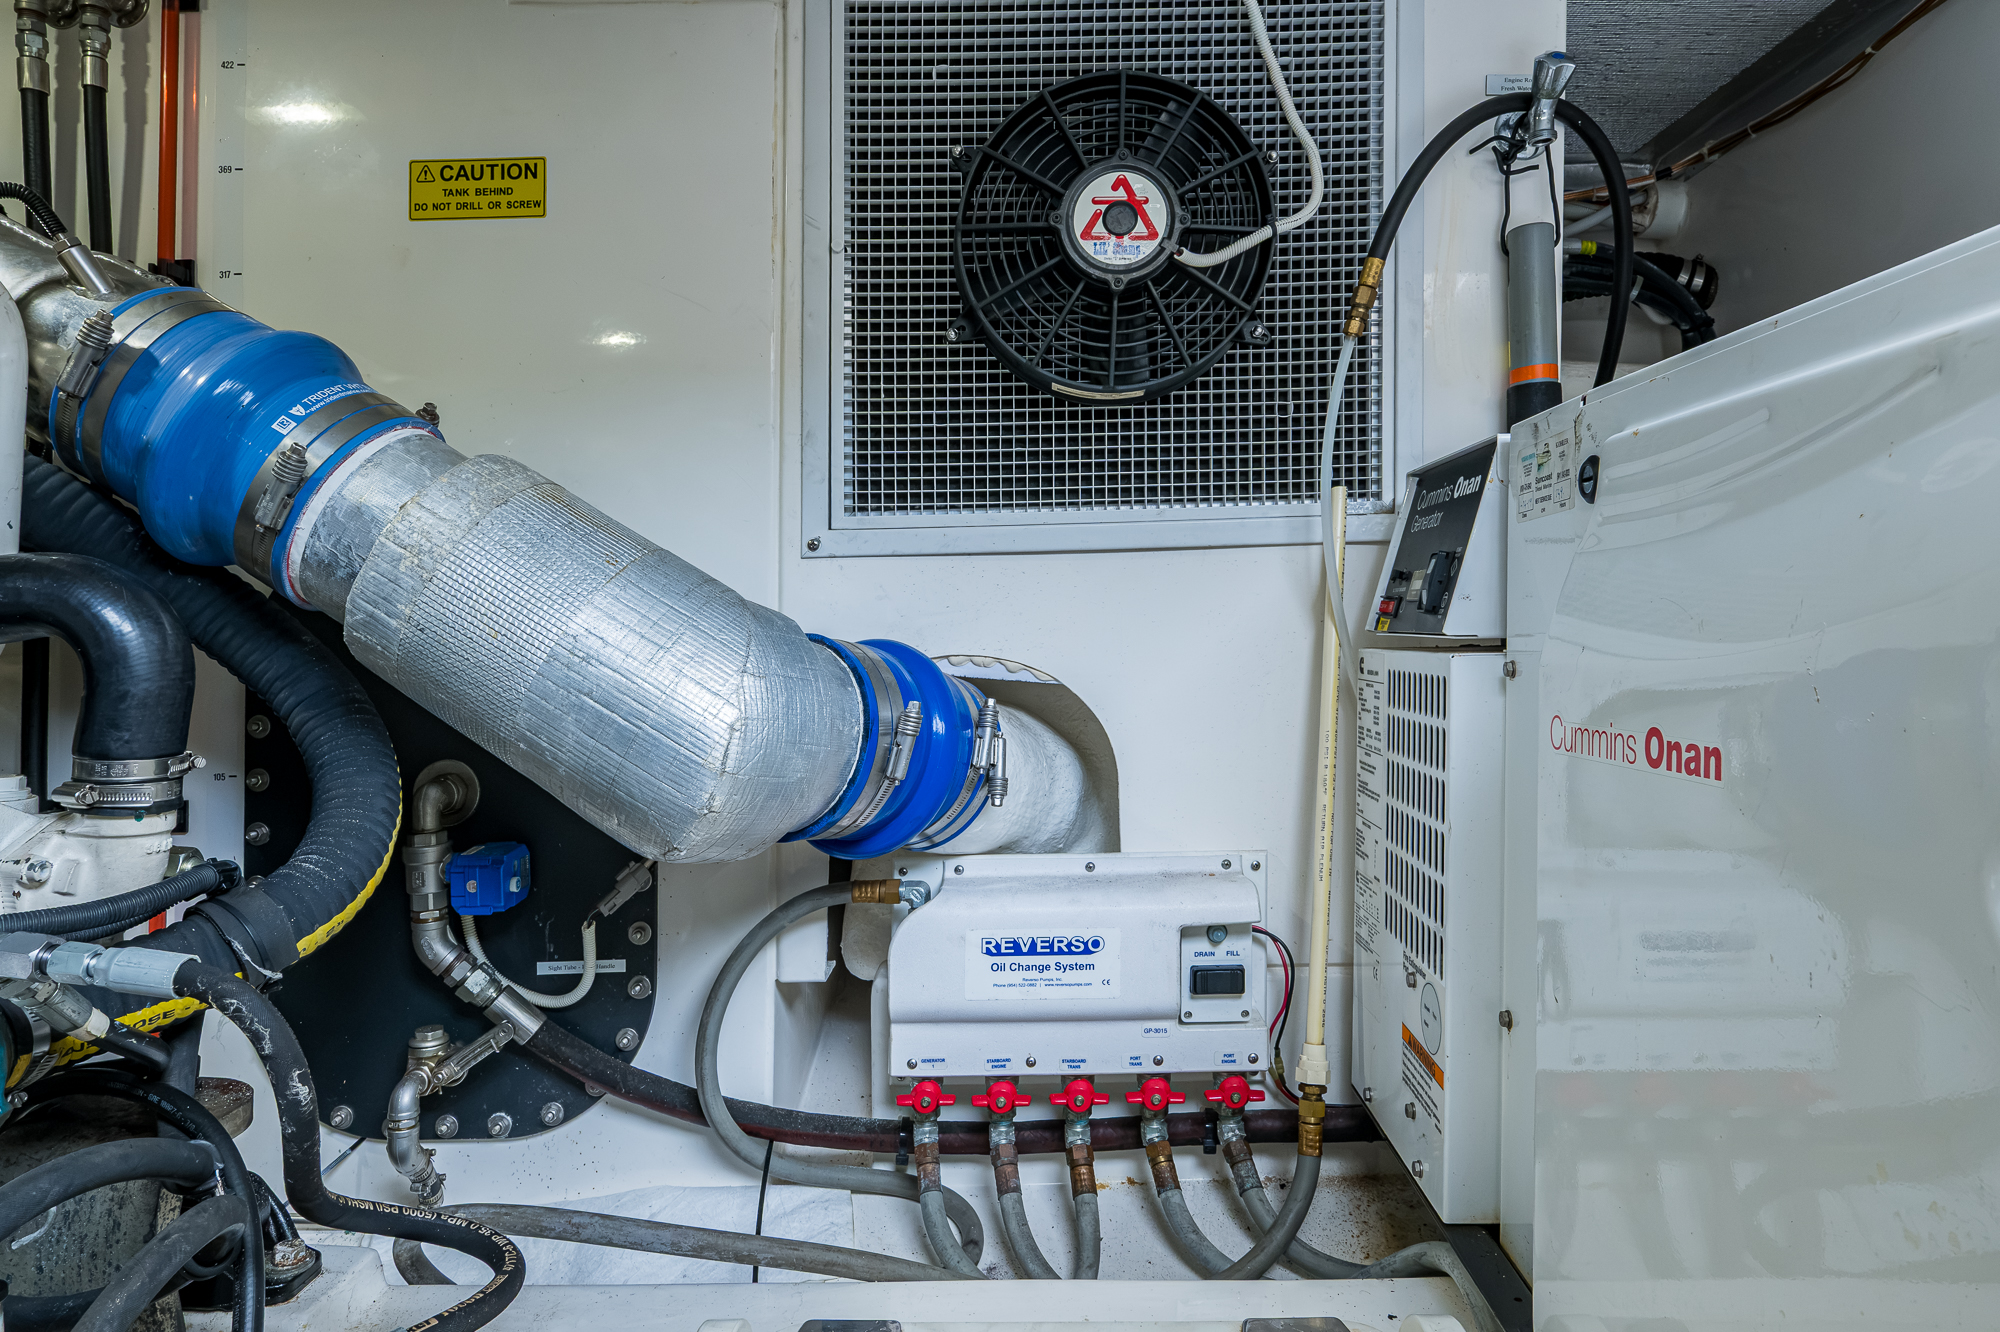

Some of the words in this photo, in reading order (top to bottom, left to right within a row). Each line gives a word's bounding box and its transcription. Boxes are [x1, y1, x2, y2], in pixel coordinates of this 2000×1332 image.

[221, 60, 235, 69] 422
[218, 165, 232, 174] 369
[440, 162, 538, 181] CAUTION
[442, 188, 470, 197] TANK
[474, 187, 514, 196] BEHIND
[414, 203, 428, 211] DO
[432, 202, 452, 211] NOT
[455, 201, 483, 210] DRILL
[487, 201, 502, 209] OR
[506, 199, 542, 209] SCREW
[219, 270, 231, 279] 317
[302, 384, 346, 405] TRIDENT
[1417, 482, 1453, 511] Cummins
[1454, 475, 1482, 498] Onan
[1411, 511, 1443, 532] Generator
[1550, 715, 1637, 765] Cummins
[1645, 726, 1722, 781] Onan
[213, 773, 226, 781] 105
[981, 936, 1105, 956] REVERSO
[548, 964, 562, 972] Sight
[990, 962, 1006, 972] Oil
[1009, 962, 1051, 973] Change
[1054, 962, 1095, 973] System
[131, 1009, 176, 1028] OSE
[375, 1202, 399, 1214] PSI)
[401, 1207, 438, 1221] (5000
[441, 1213, 469, 1228] MPa
[470, 1223, 492, 1237] 35.0
[491, 1233, 509, 1246] WP
